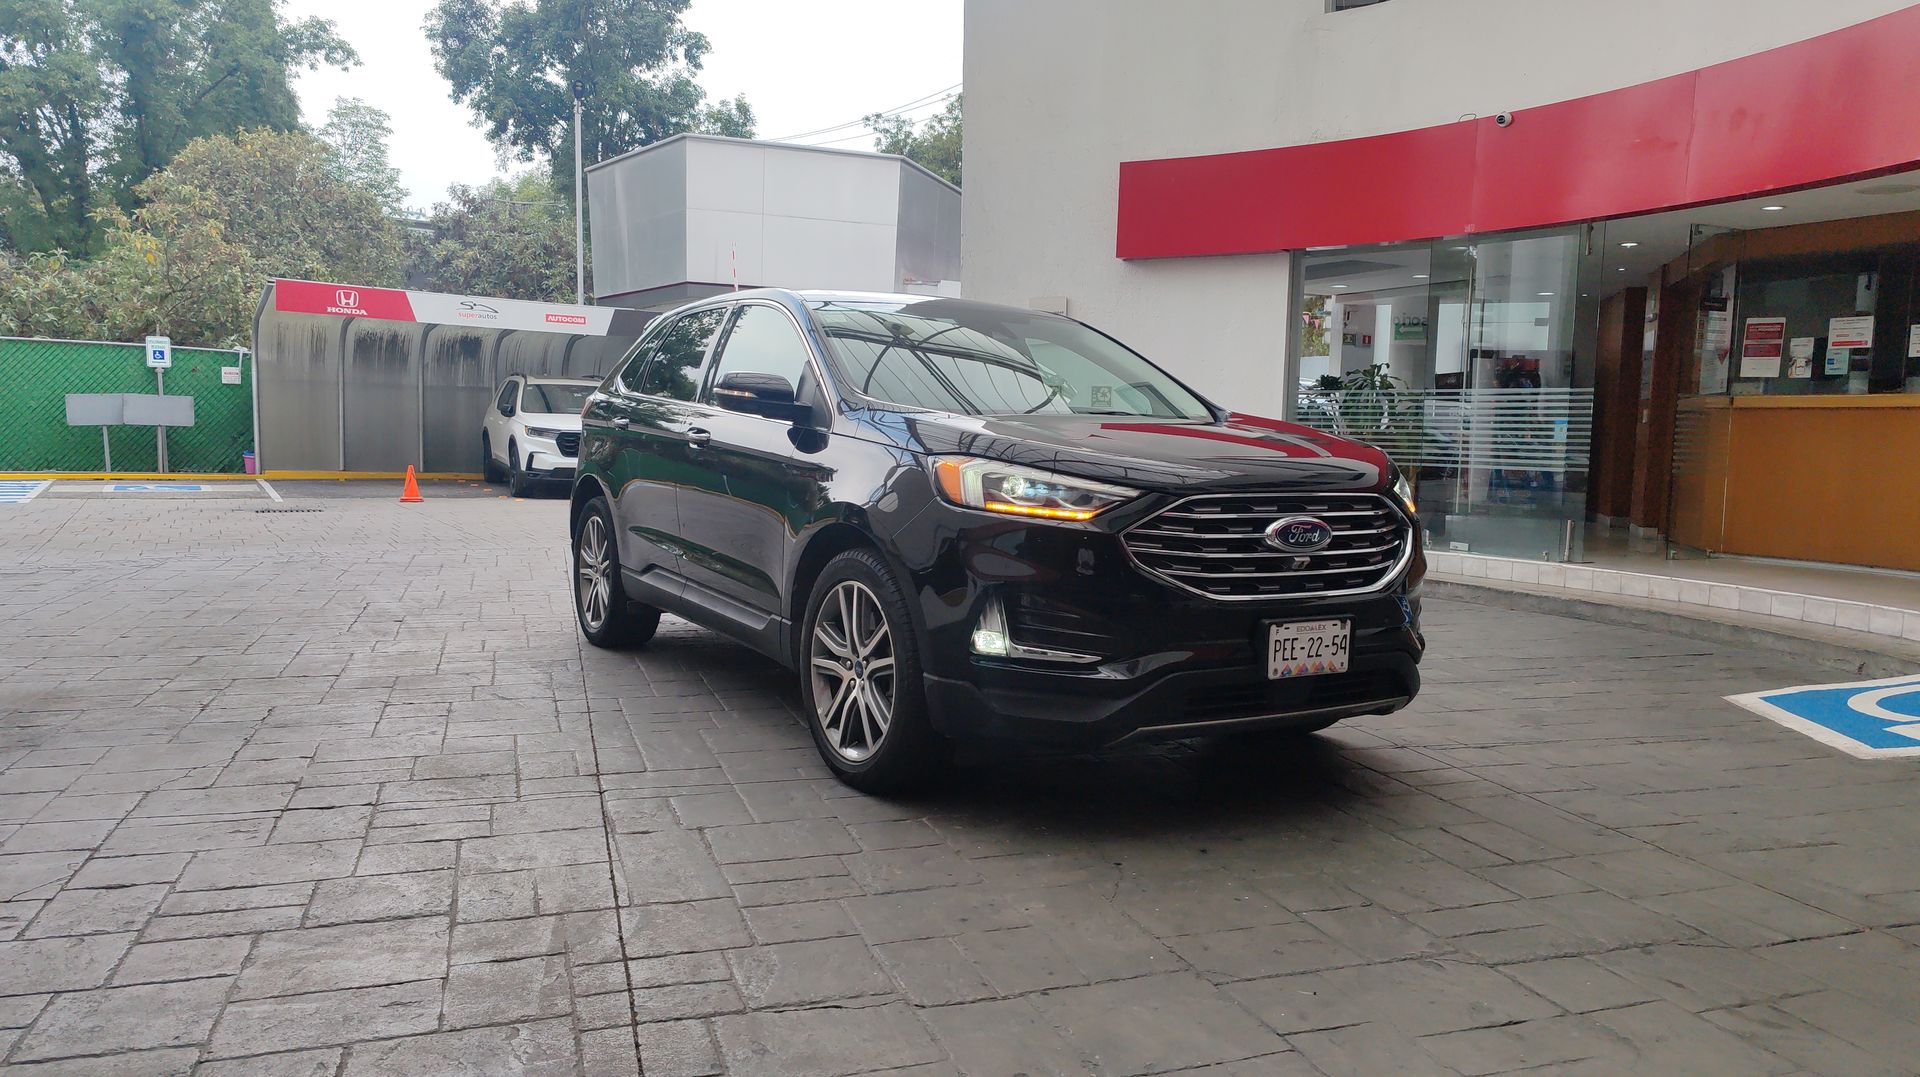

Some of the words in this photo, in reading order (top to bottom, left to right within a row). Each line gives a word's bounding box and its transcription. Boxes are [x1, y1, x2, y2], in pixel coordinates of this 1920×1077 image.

[327, 307, 368, 315] HONDA
[458, 312, 498, 320] superautos
[548, 315, 585, 324] AUTOCOM
[1288, 524, 1321, 543] Ford
[1274, 634, 1347, 662] PEE-22-54
